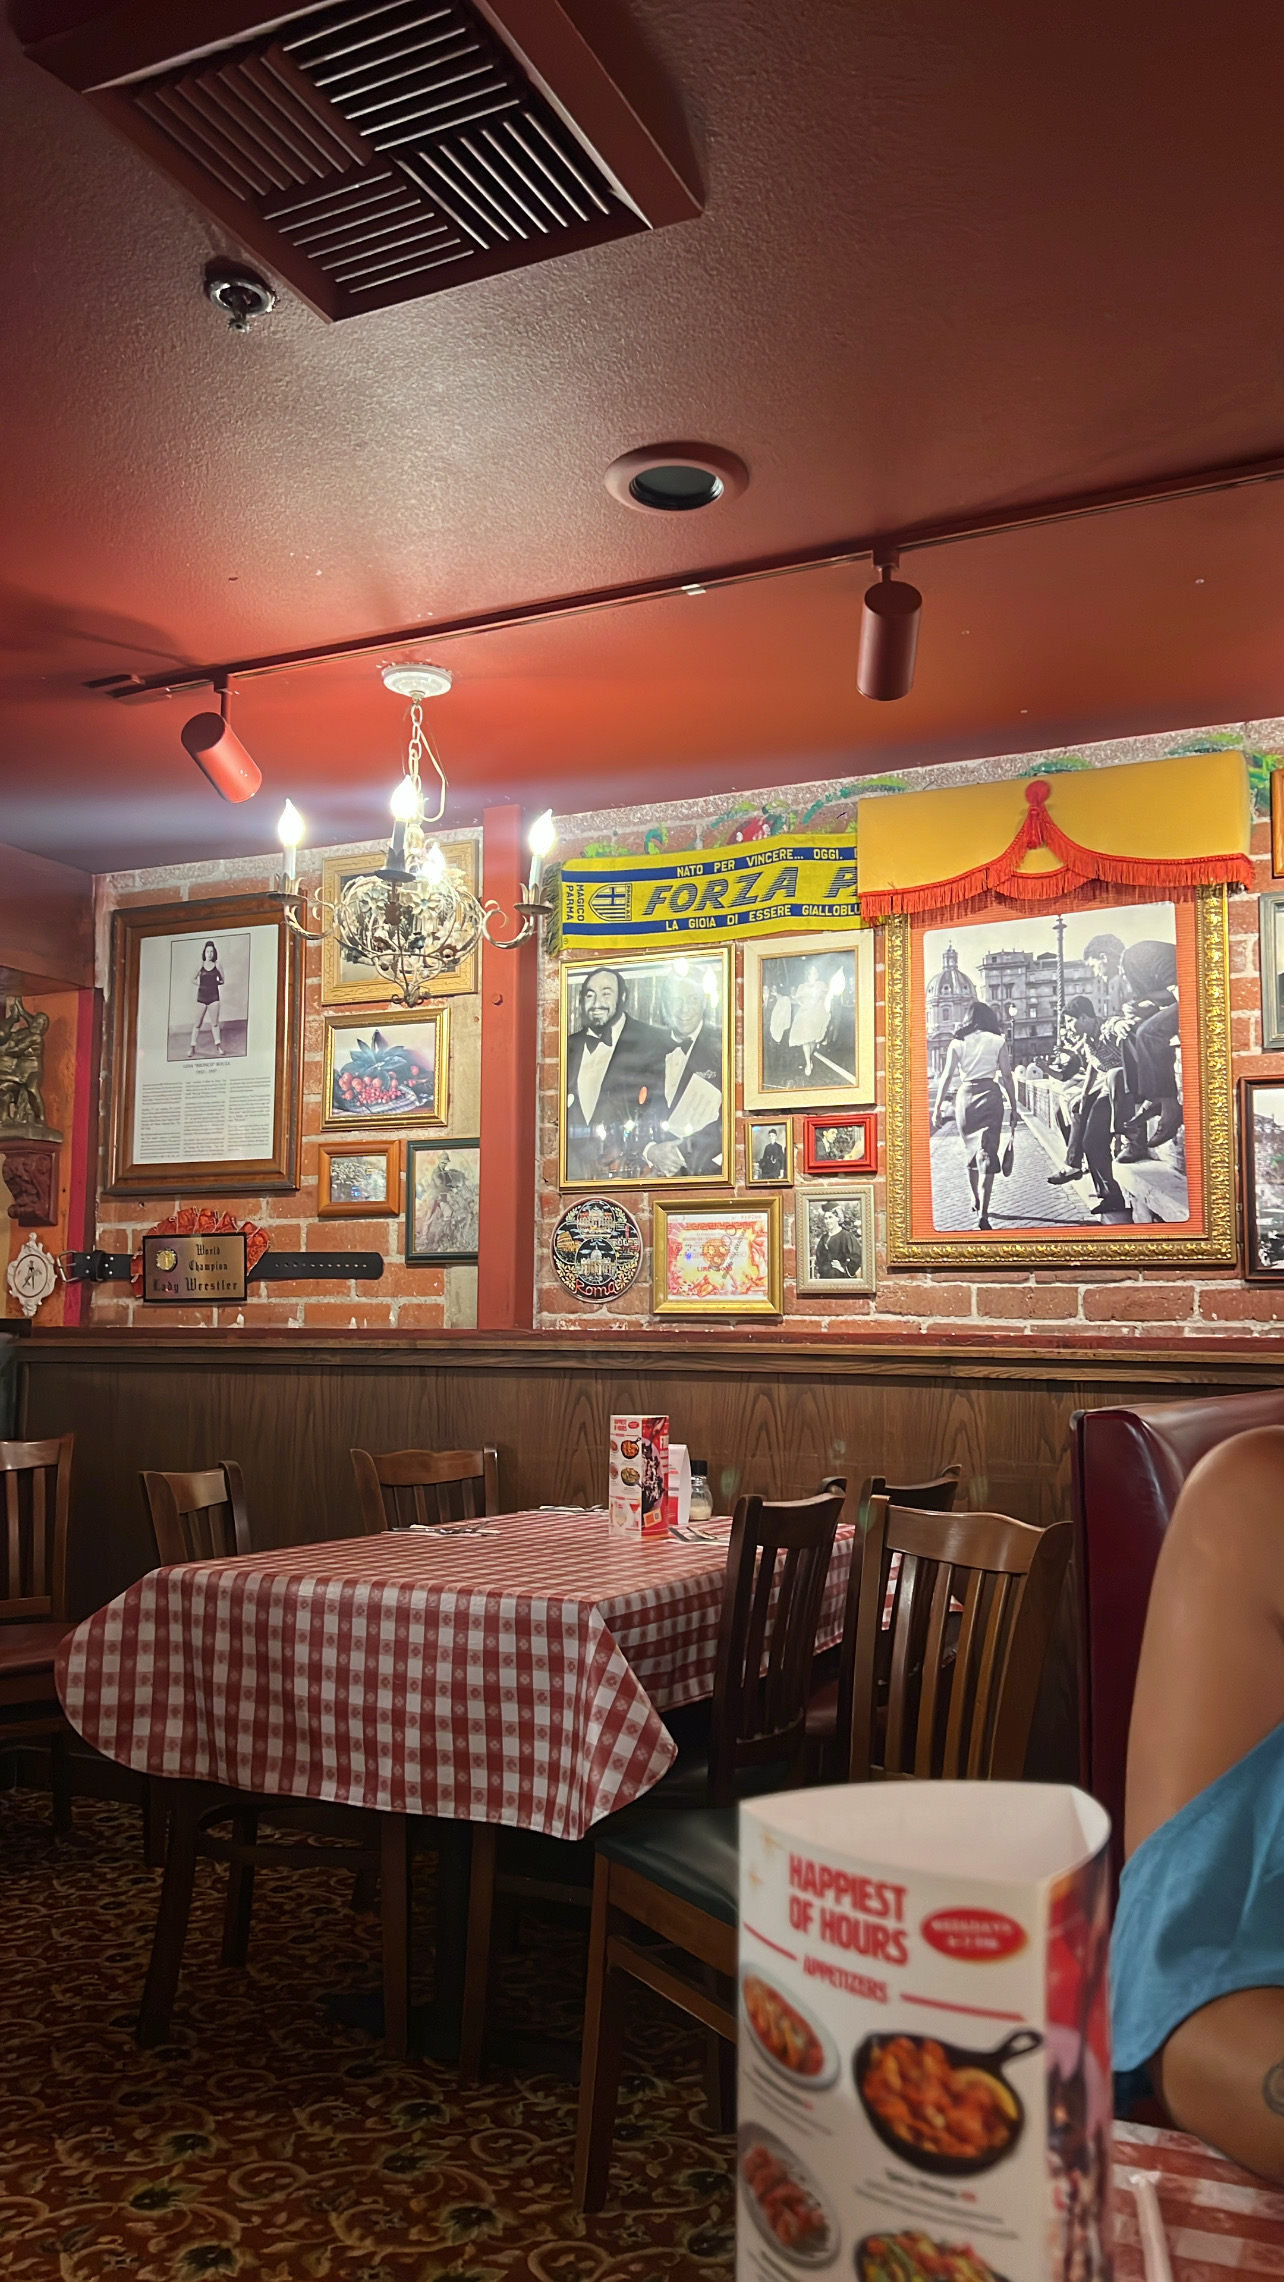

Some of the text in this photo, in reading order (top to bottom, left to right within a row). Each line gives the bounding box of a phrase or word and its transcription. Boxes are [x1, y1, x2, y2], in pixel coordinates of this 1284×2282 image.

[677, 848, 843, 878] NATO PER VINCERE... OGGI.
[566, 885, 574, 921] PARMA
[576, 884, 585, 922] MAGICO
[641, 866, 857, 916] FORZA P
[665, 919, 679, 931] LA
[688, 916, 716, 929] GIOIA
[726, 913, 739, 926] DI
[748, 904, 792, 922] ESSERE
[196, 1244, 221, 1256] World
[188, 1260, 228, 1272] Champion
[153, 1277, 238, 1294] Lady Wrestler
[573, 1279, 619, 1297] Roma
[789, 1852, 908, 1924] HAPPIEST
[789, 1893, 909, 1967] OF HOURS
